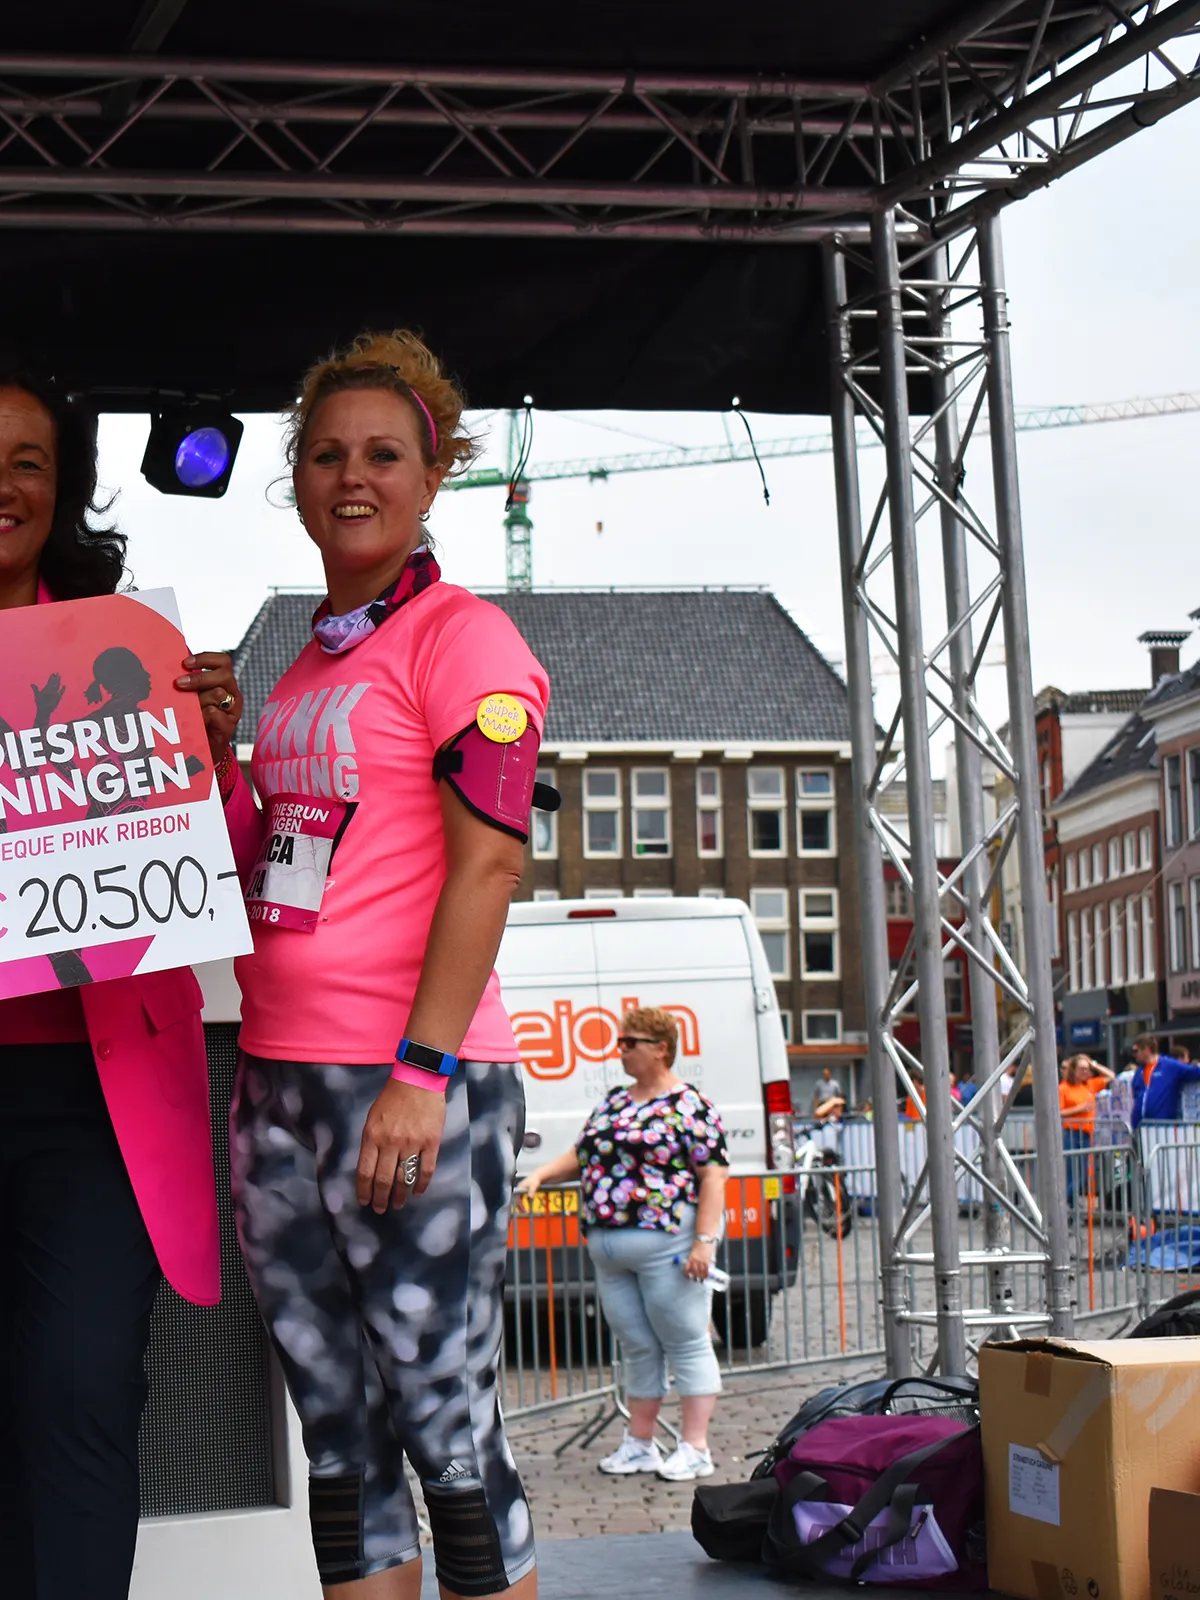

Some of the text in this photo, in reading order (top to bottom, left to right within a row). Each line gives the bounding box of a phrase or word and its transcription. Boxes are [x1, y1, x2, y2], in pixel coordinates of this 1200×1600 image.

[483, 717, 518, 737] MAMA
[258, 755, 360, 799] NNING
[272, 803, 329, 823] DIESRUN
[62, 826, 110, 851] PINK
[117, 812, 191, 842] RIBBON
[19, 855, 238, 938] 20.500,-
[247, 904, 281, 923] -2018
[509, 996, 700, 1081] ejon
[439, 1469, 472, 1483] adidas
